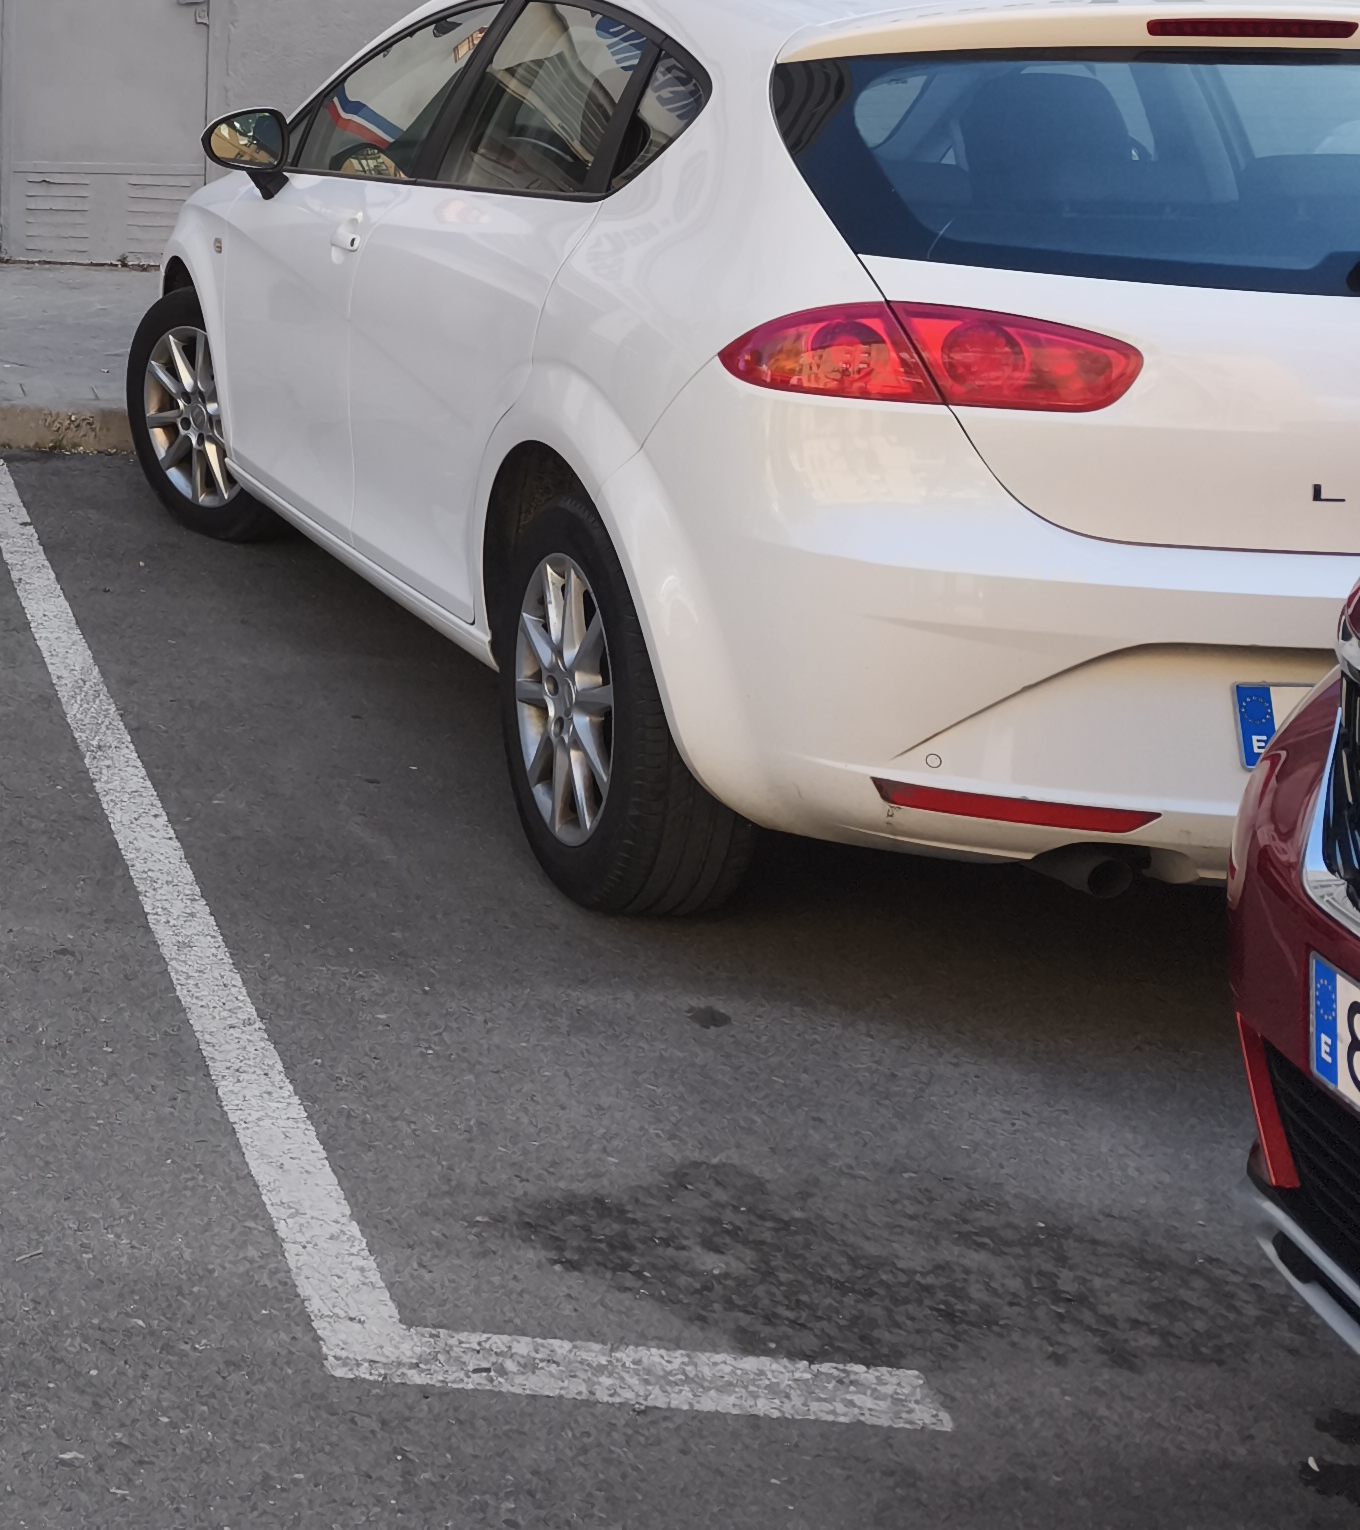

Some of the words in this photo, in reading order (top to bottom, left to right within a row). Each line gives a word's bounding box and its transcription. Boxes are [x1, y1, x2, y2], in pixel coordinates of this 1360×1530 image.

[1313, 484, 1346, 502] L
[1252, 735, 1268, 754] E
[1320, 1032, 1332, 1064] E
